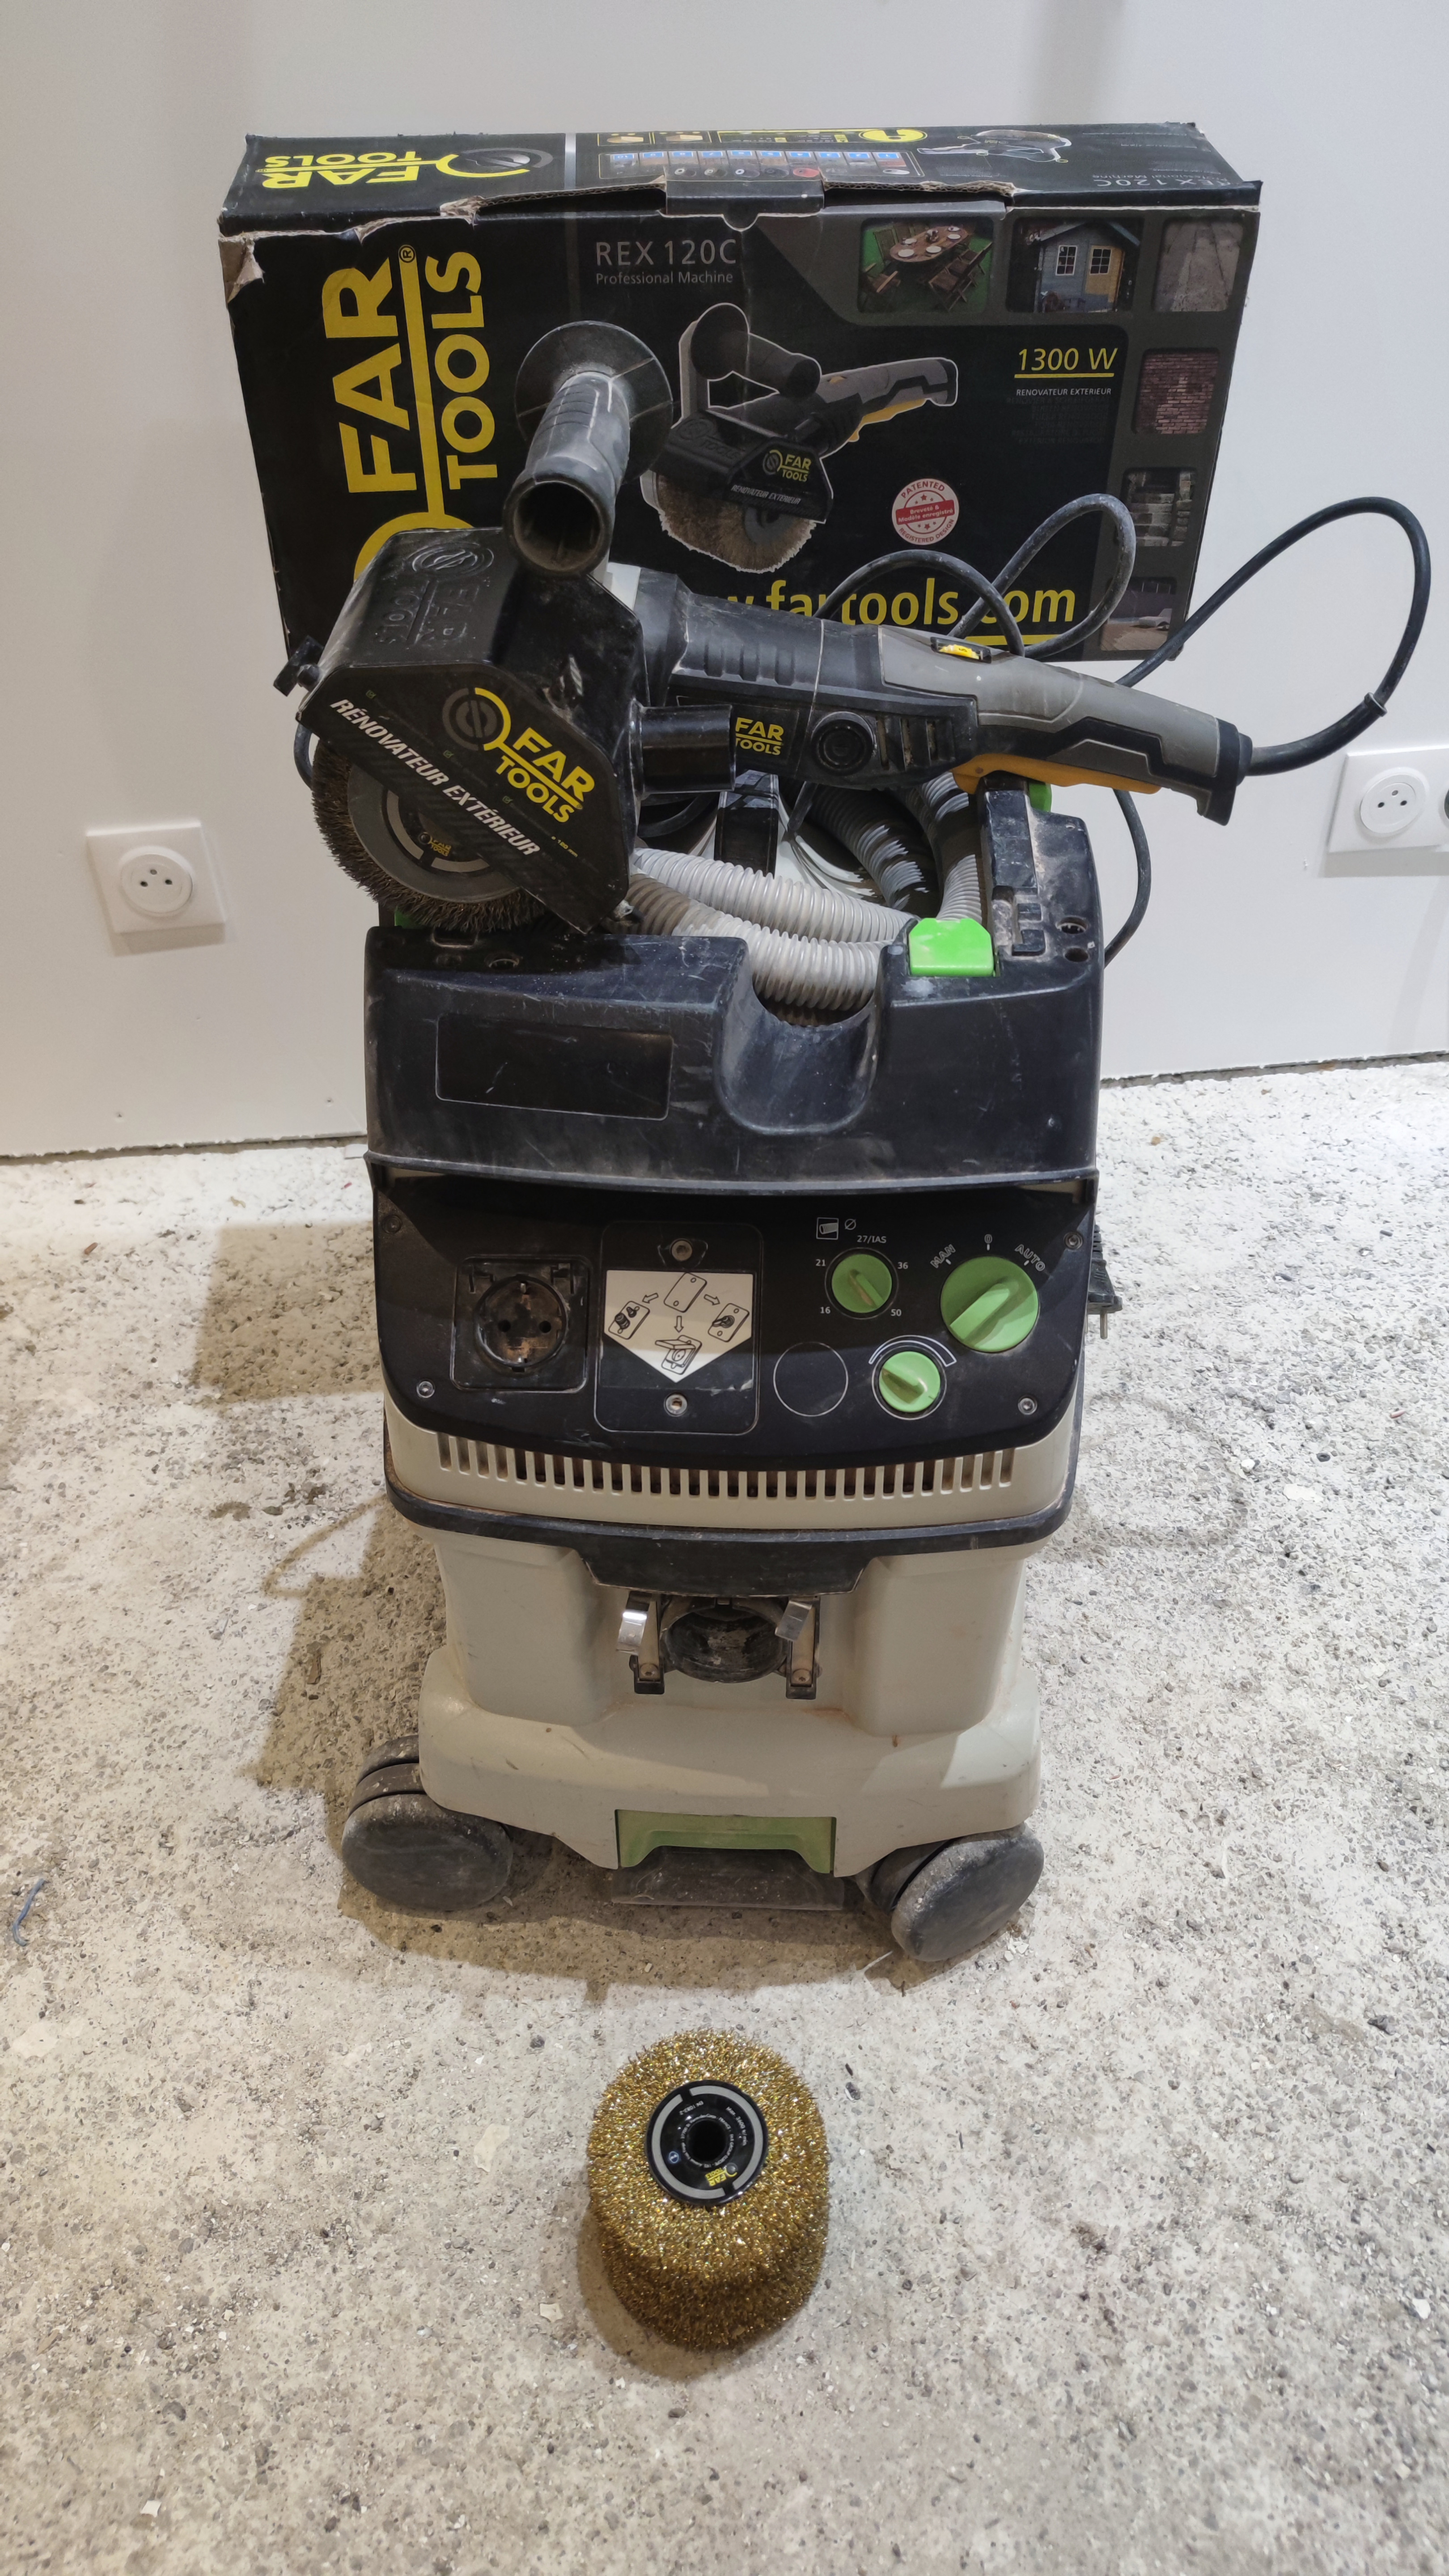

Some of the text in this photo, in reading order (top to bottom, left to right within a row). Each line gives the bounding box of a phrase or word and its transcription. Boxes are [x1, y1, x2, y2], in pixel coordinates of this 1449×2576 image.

[265, 151, 422, 167] TOOLS
[262, 165, 420, 189] FAR
[1093, 178, 1167, 186] 120C
[596, 239, 736, 266] REX 120C
[596, 270, 733, 284] Professional Machine
[1019, 347, 1118, 371] 1300 W
[322, 256, 417, 492] FAR
[425, 251, 498, 490] TOOLS
[785, 454, 812, 470] FAR
[782, 470, 808, 482] TOOLS
[901, 481, 945, 499] PATENTED
[898, 508, 953, 522] Modèle enregistré
[910, 505, 933, 515] Breveté
[899, 519, 954, 543] REGISTERED DESIGN
[735, 717, 784, 741] FAR
[512, 727, 595, 802] FAR
[330, 699, 449, 786] RÉNOVATEUR
[442, 785, 540, 855] EXTÉRIEUR
[496, 755, 575, 822] TOOLS
[856, 1235, 887, 1243] 27/IAS
[984, 1233, 993, 1244] 0
[898, 1261, 909, 1270] 36
[930, 1244, 957, 1269] MAN
[1014, 1243, 1046, 1272] AUTO
[820, 1306, 831, 1314] 16
[890, 1309, 902, 1317] 50
